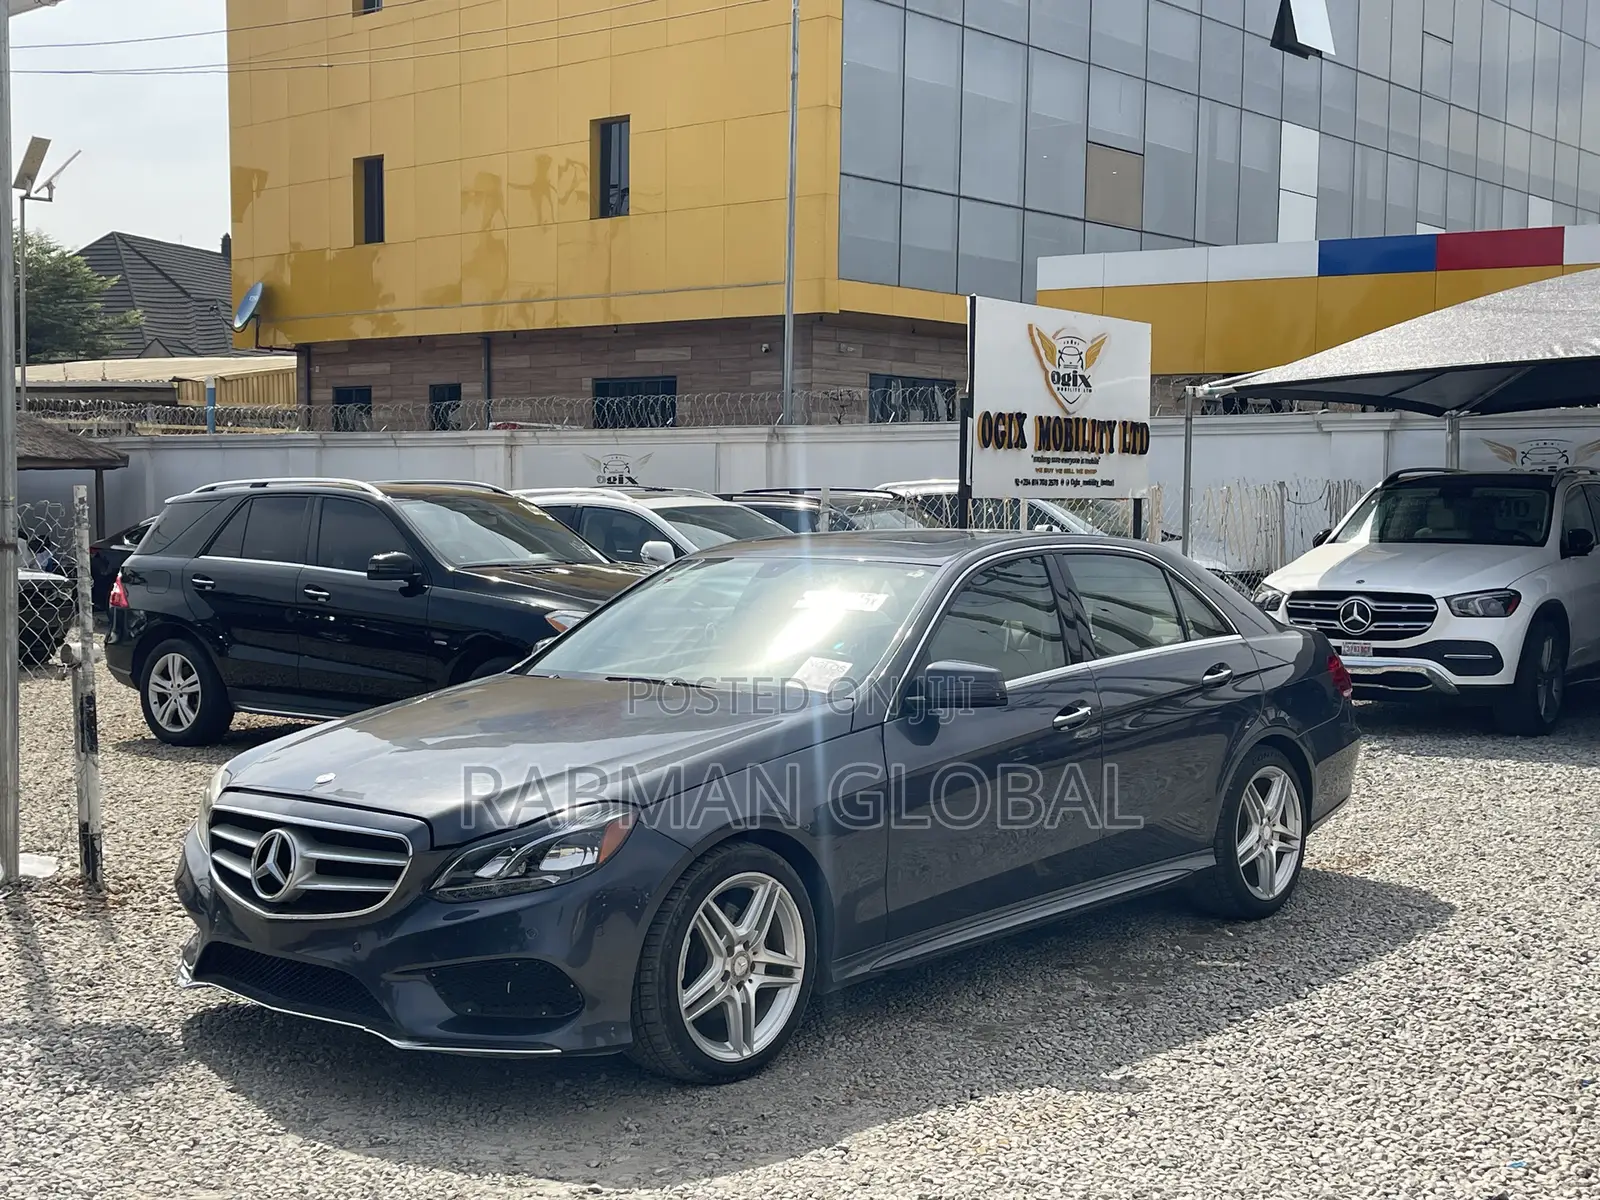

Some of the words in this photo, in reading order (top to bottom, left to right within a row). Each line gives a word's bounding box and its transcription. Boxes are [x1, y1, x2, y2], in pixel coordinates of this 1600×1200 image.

[978, 411, 1028, 450] OGIX
[1034, 415, 1117, 454] MOBILITY
[1118, 420, 1150, 455] LTD
